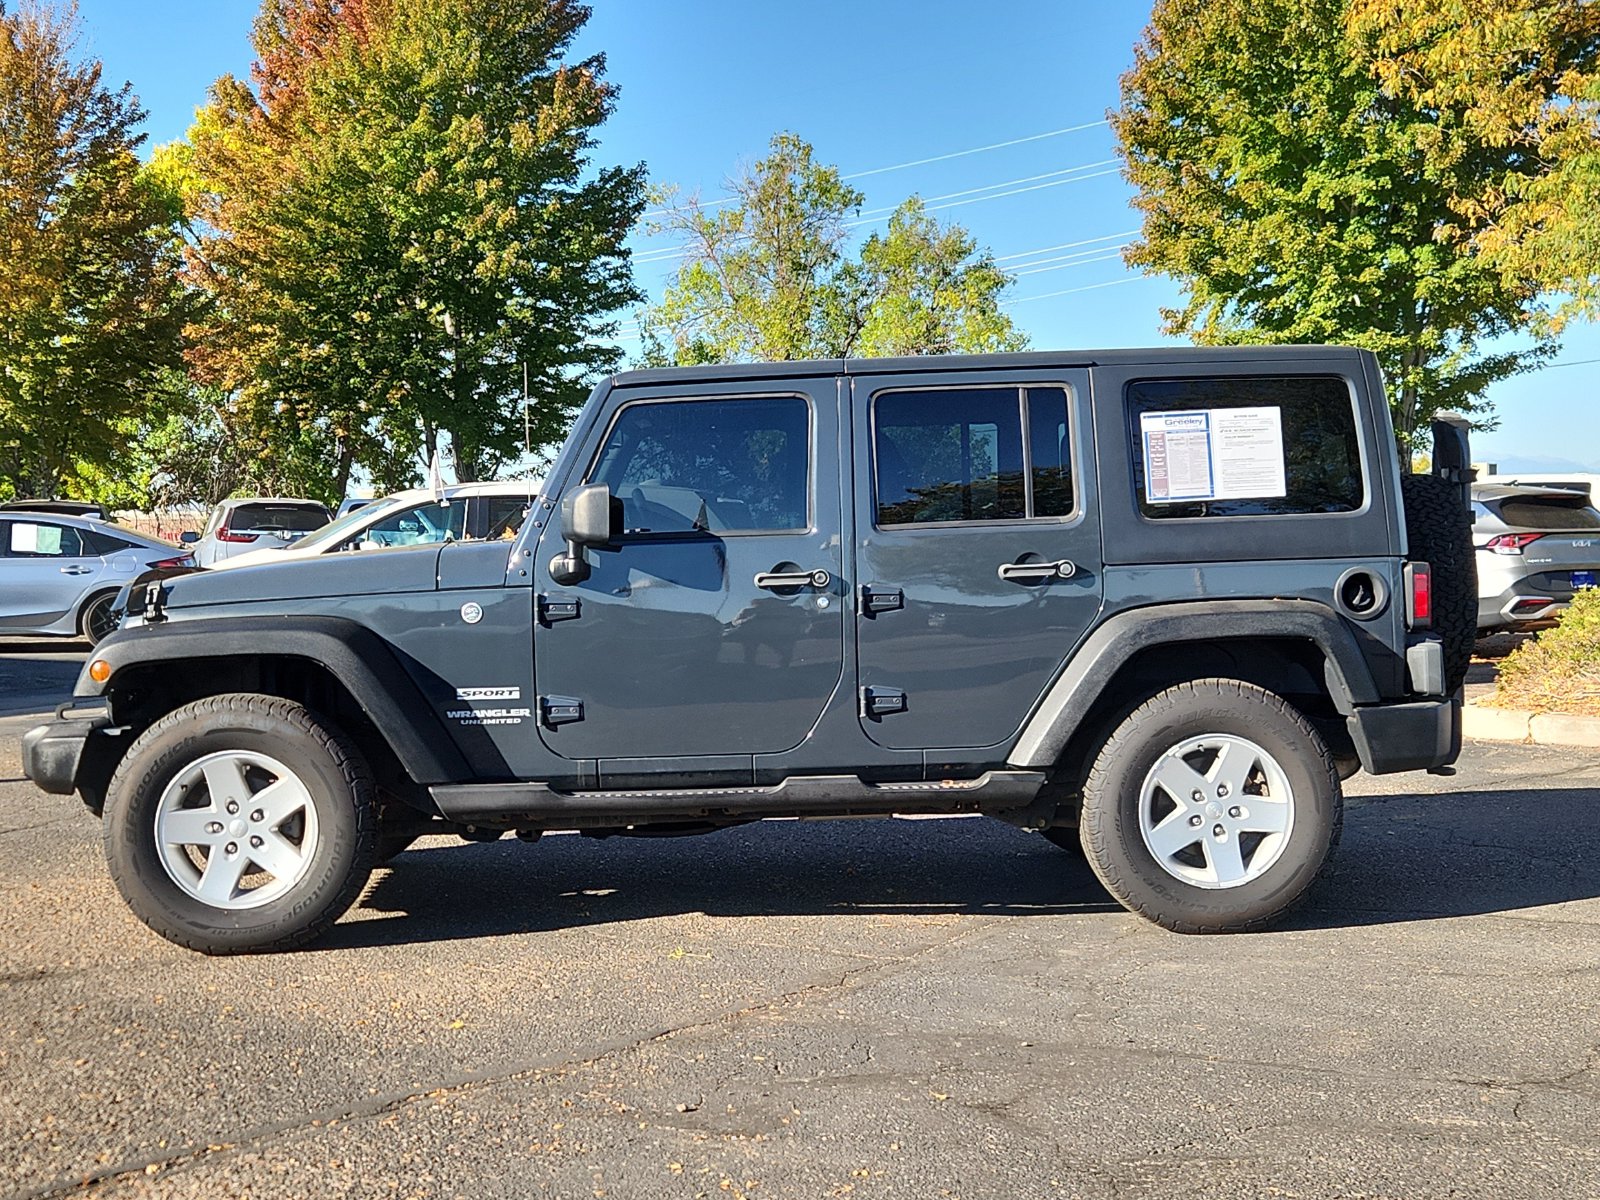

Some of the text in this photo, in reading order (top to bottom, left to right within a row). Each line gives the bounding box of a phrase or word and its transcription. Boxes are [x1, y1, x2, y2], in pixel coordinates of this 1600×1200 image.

[1164, 417, 1203, 426] Greeley
[462, 689, 515, 697] SPORT
[446, 708, 531, 719] WRANGLER
[125, 735, 198, 844] BFGoodrich
